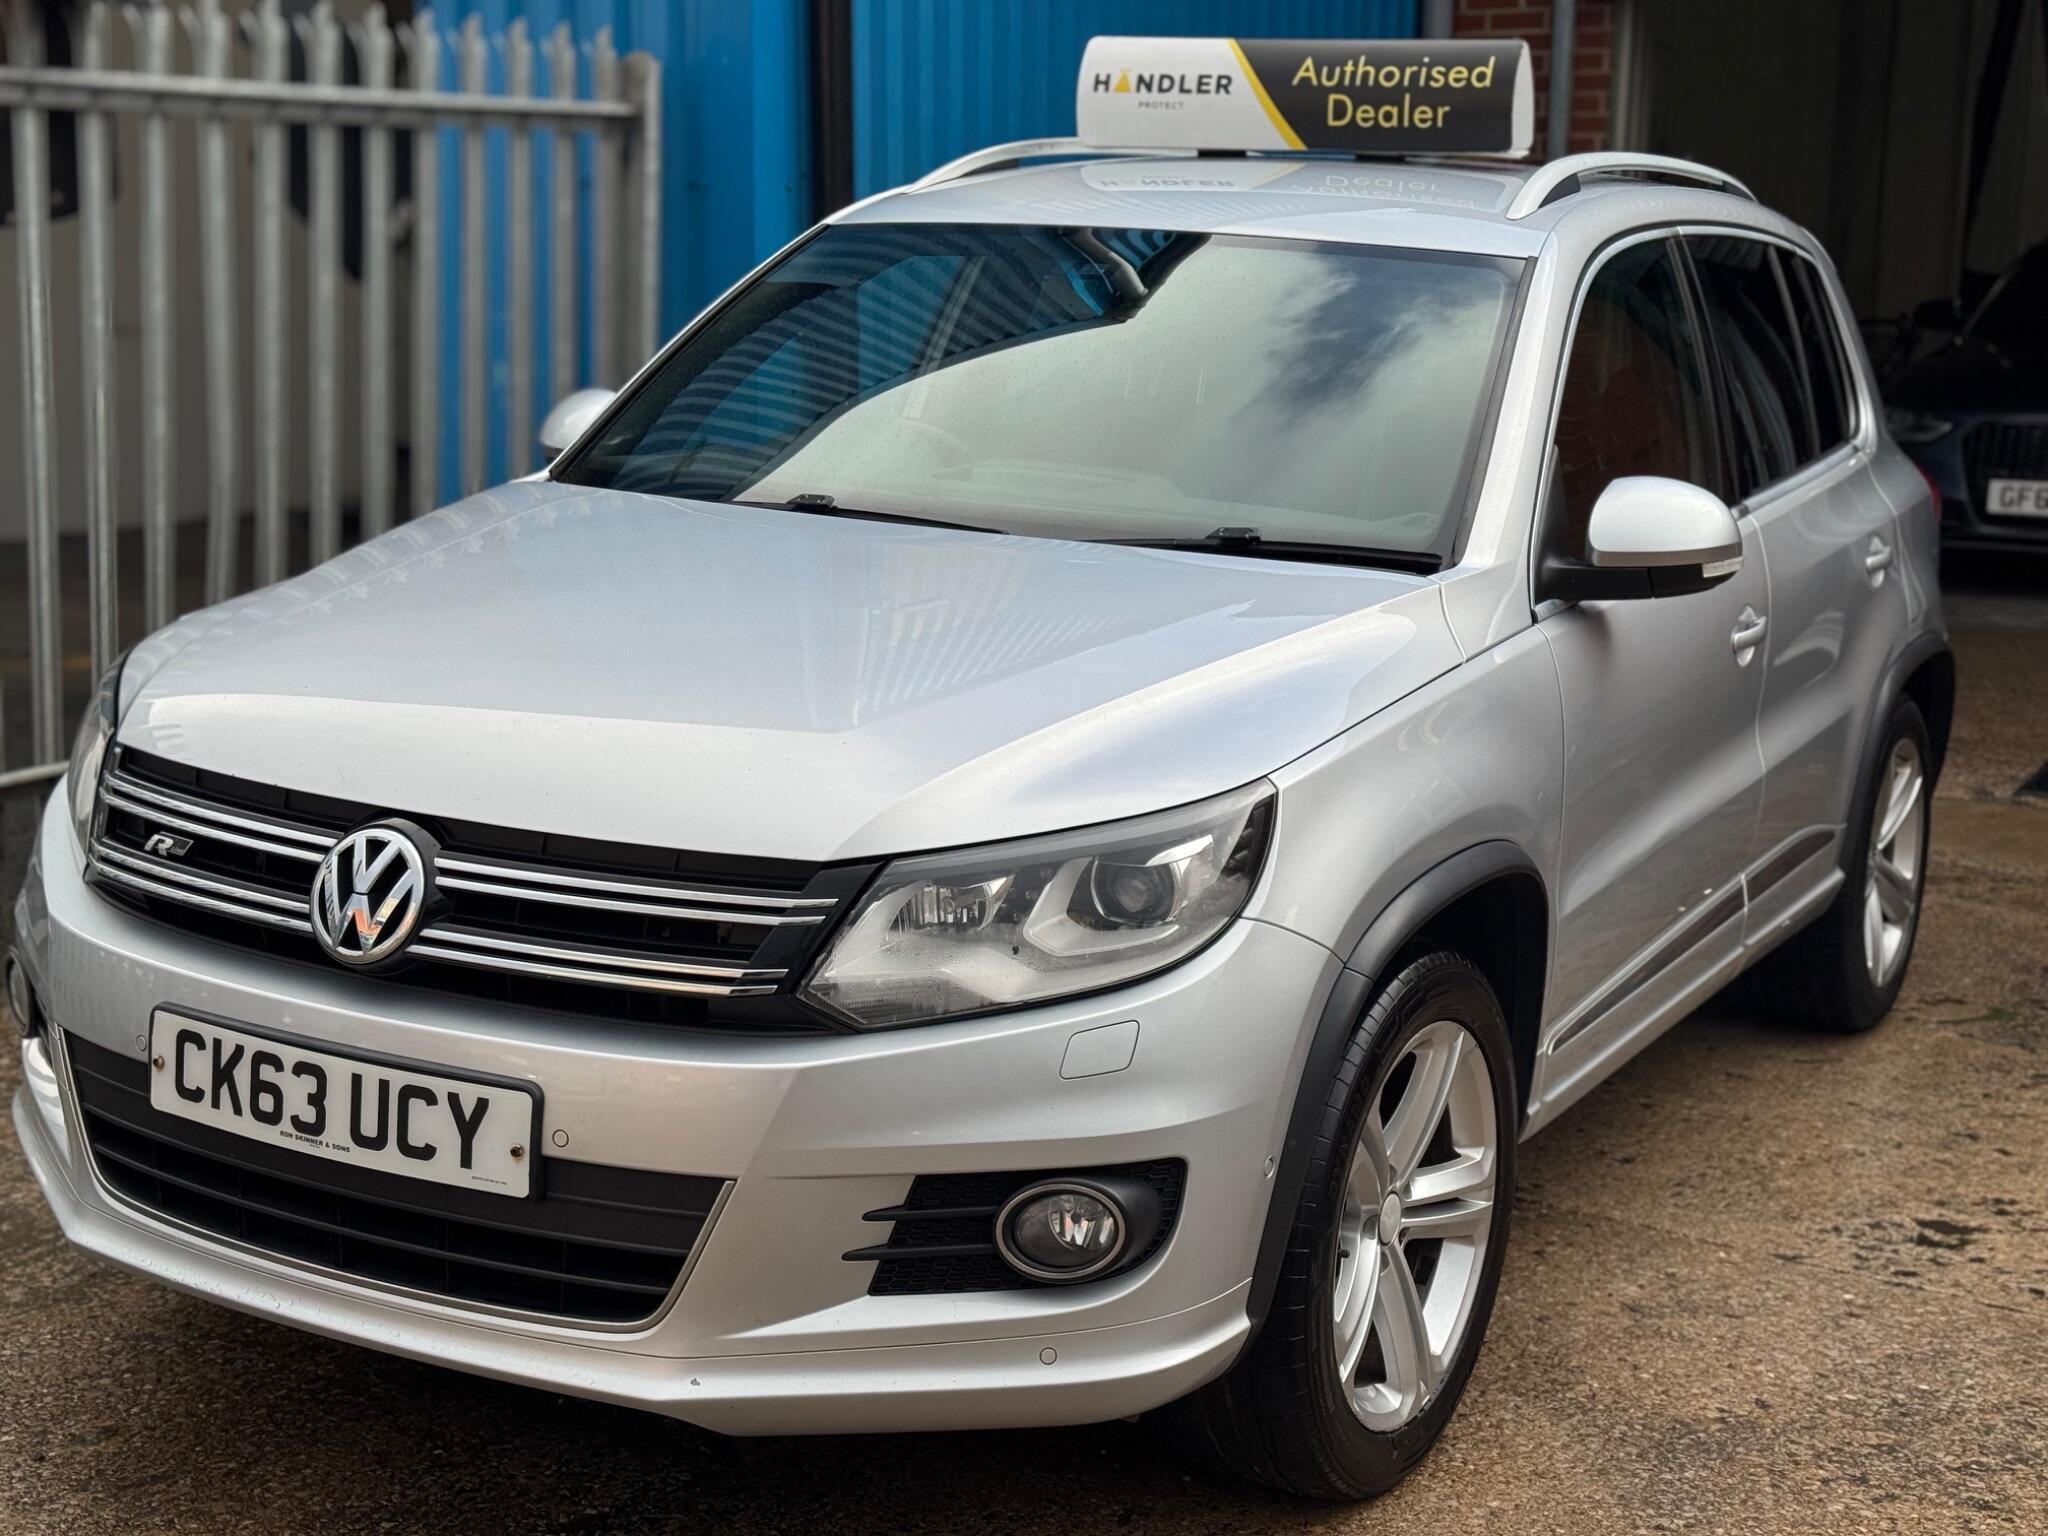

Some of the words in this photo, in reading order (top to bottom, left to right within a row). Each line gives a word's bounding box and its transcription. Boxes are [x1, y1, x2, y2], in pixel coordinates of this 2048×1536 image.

[1292, 55, 1496, 88] Authorised
[1138, 101, 1184, 110] PROTECT
[1326, 94, 1450, 128] Dealer
[175, 1028, 327, 1138] CK63
[349, 1073, 490, 1170] UCY
[295, 1134, 323, 1147] SKINNER
[332, 1144, 350, 1153] SONS
